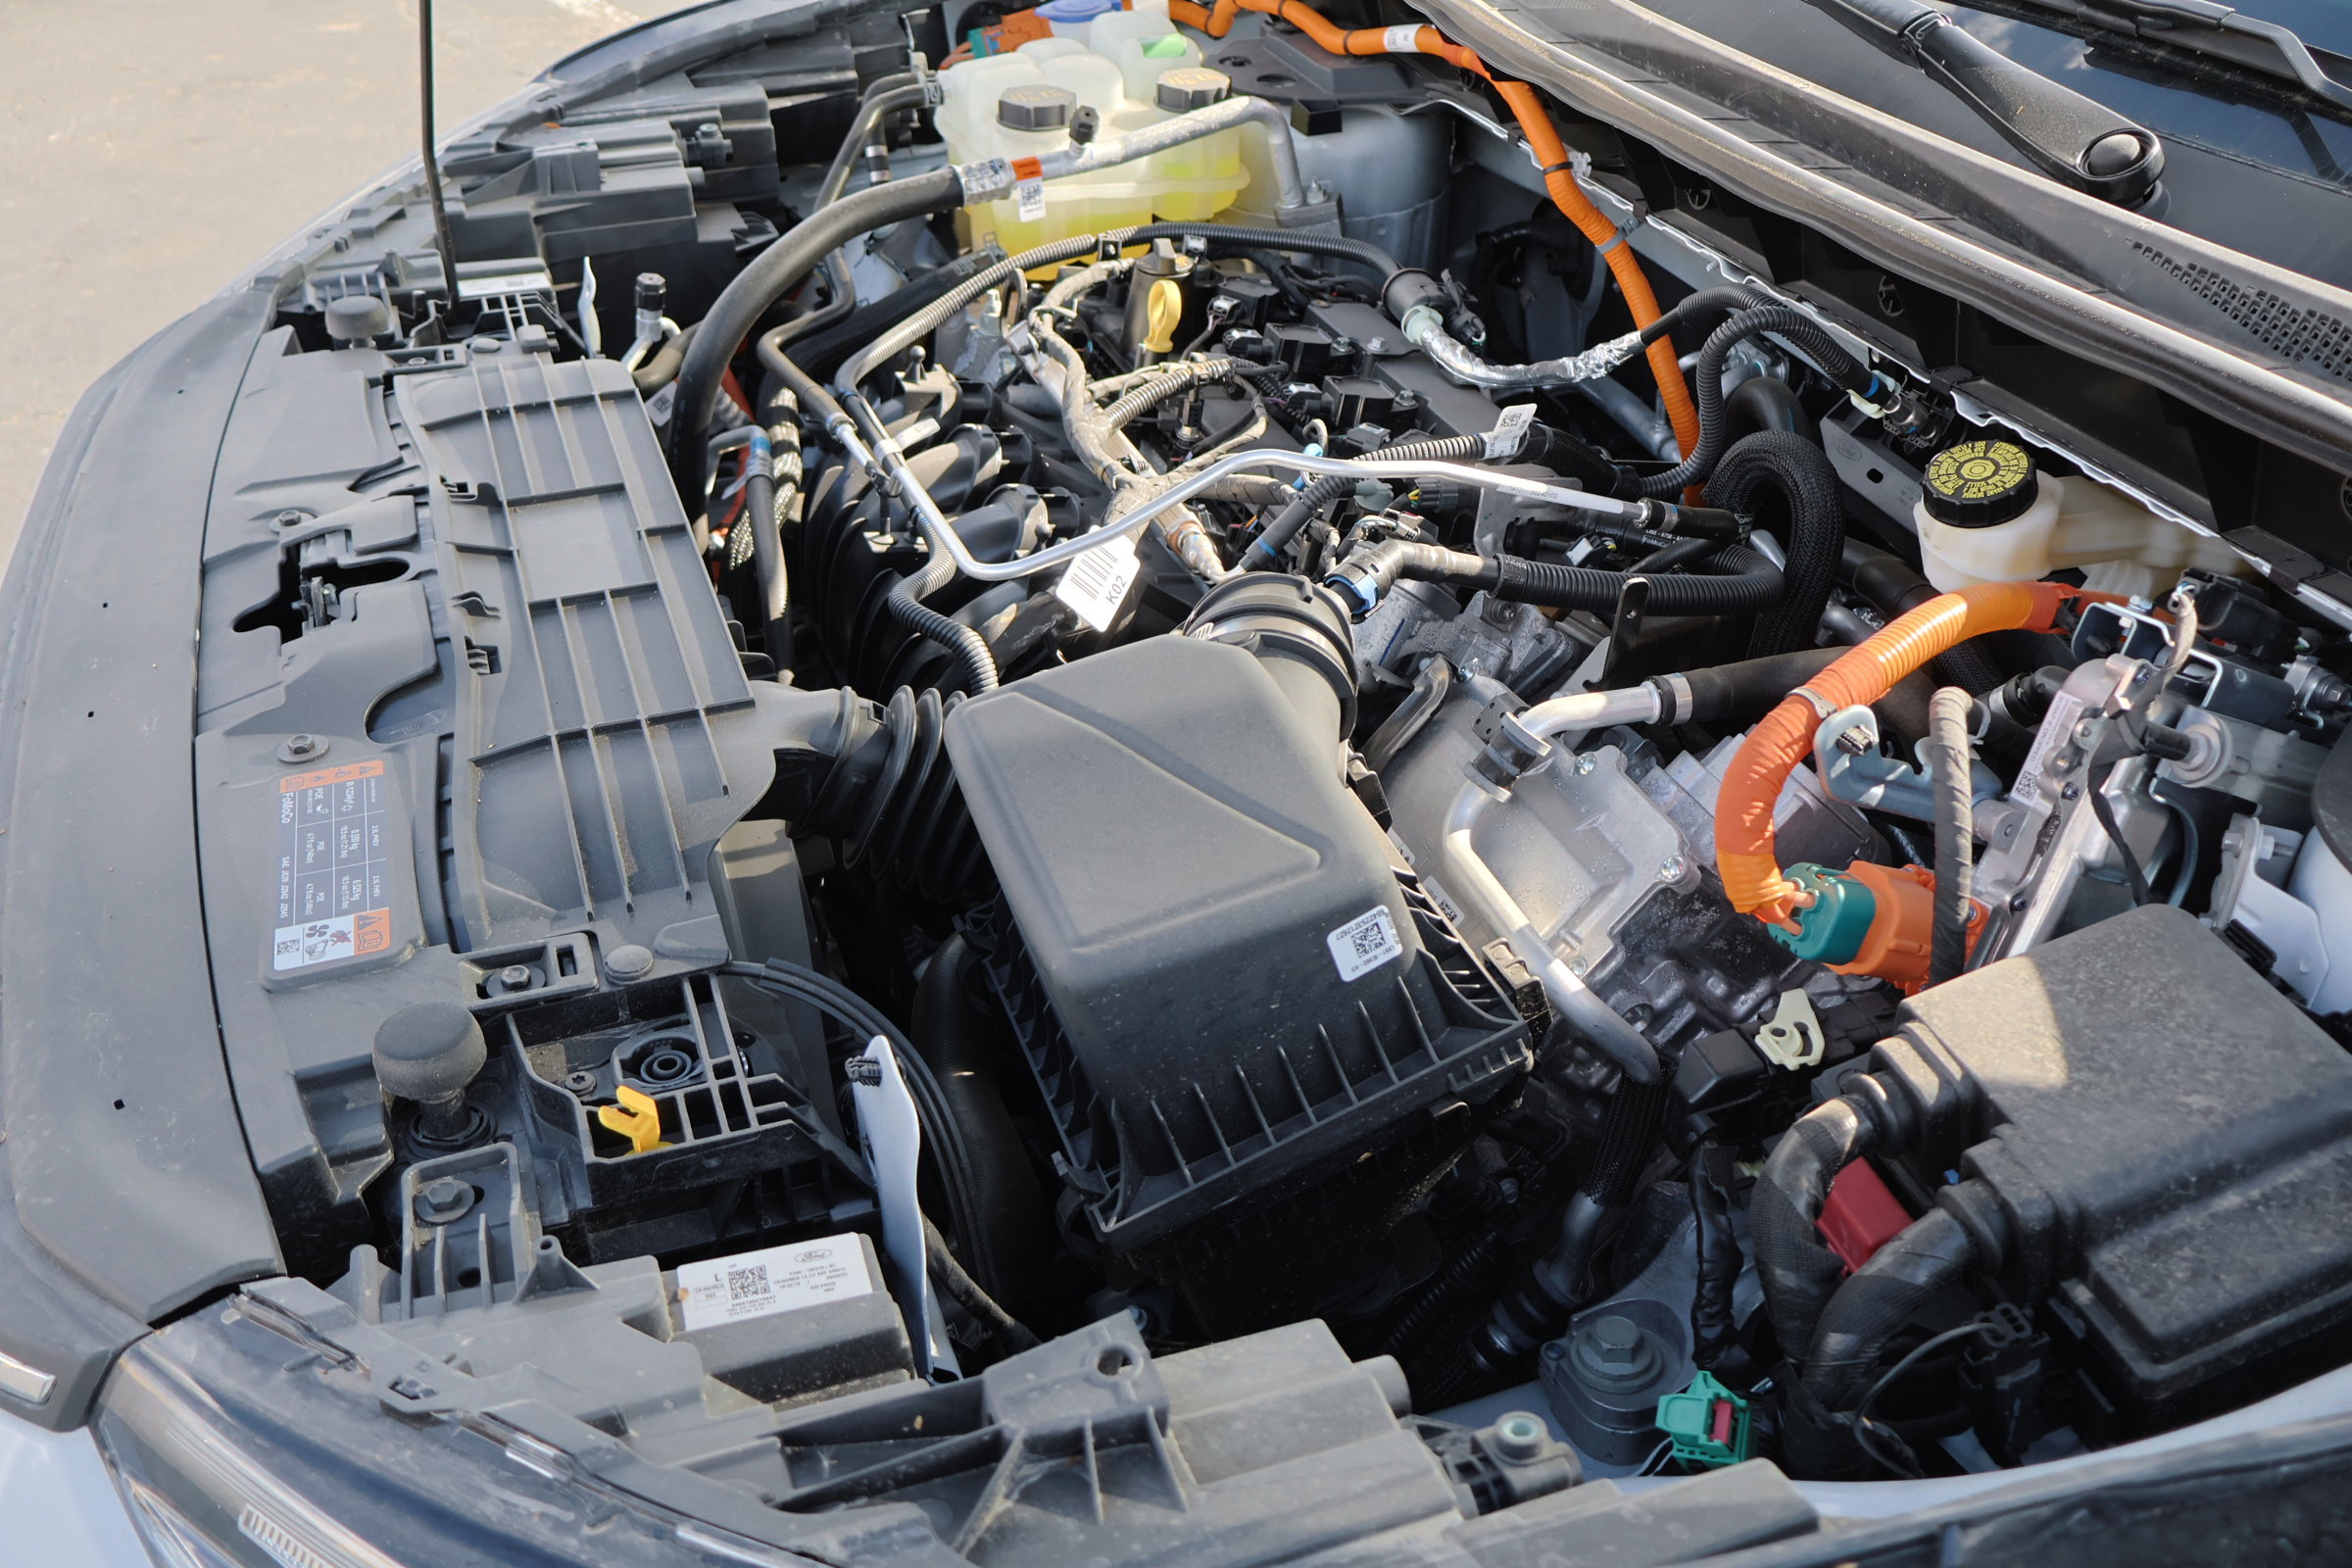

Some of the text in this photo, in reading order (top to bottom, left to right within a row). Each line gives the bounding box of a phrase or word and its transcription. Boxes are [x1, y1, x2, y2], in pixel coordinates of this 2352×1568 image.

[1105, 575, 1127, 605] K02
[343, 780, 354, 805] R-1234yf
[280, 791, 293, 824] FoMoCo
[348, 842, 360, 851] kg
[350, 892, 361, 901] kg
[713, 1272, 721, 1282] L
